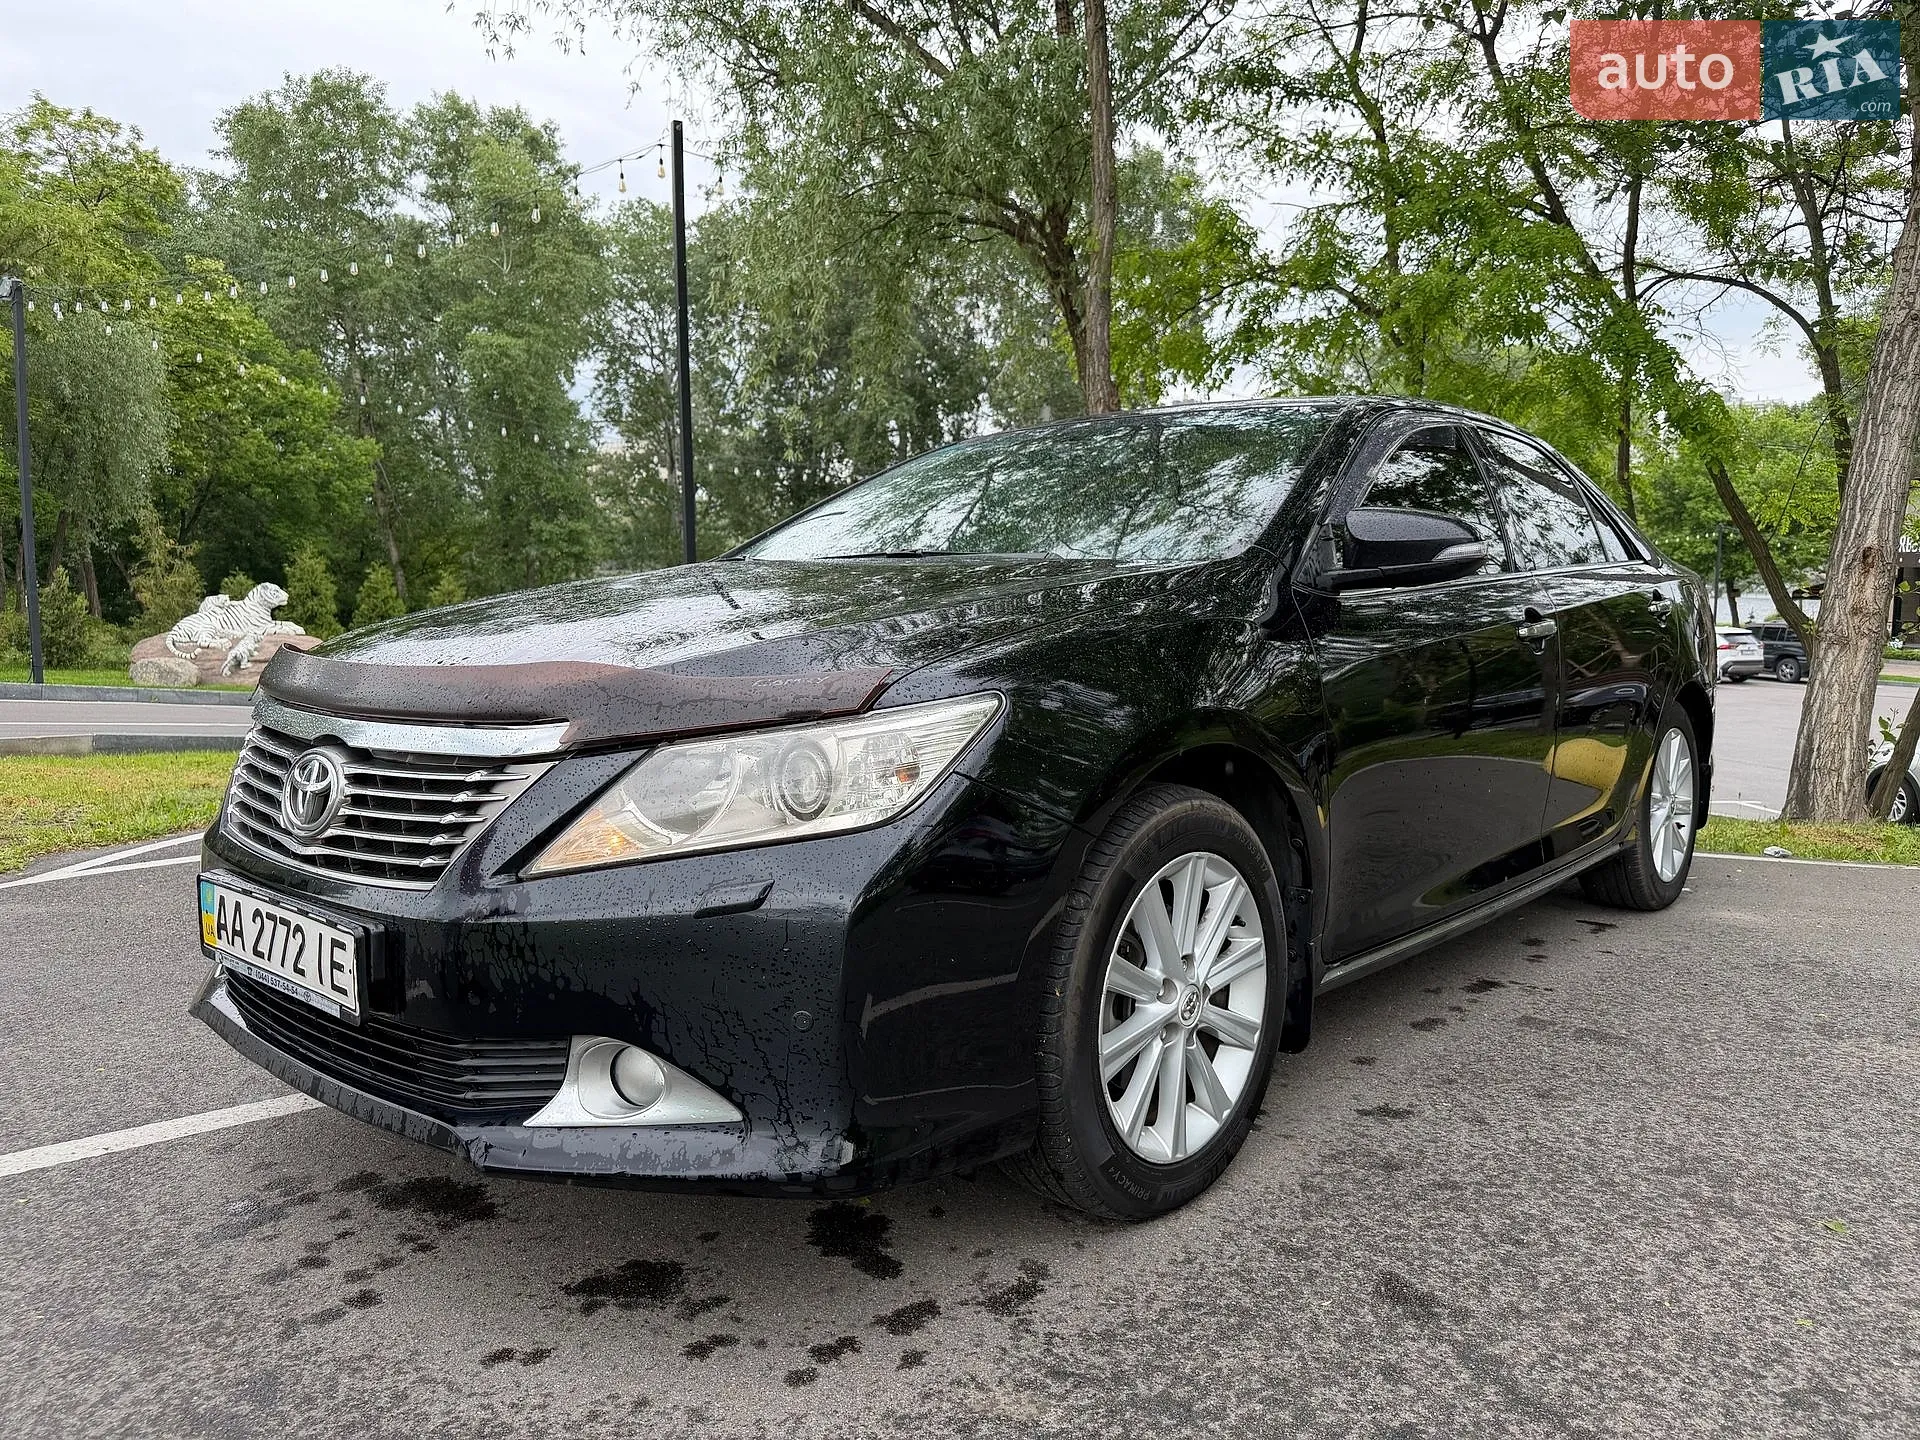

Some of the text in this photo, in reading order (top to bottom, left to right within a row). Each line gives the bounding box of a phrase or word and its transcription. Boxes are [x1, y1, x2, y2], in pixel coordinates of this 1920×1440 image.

[205, 921, 216, 938] UA
[216, 894, 349, 998] AA 2772 IE
[271, 975, 298, 996] 537-54-54
[1112, 1170, 1152, 1201] PRIMACY
